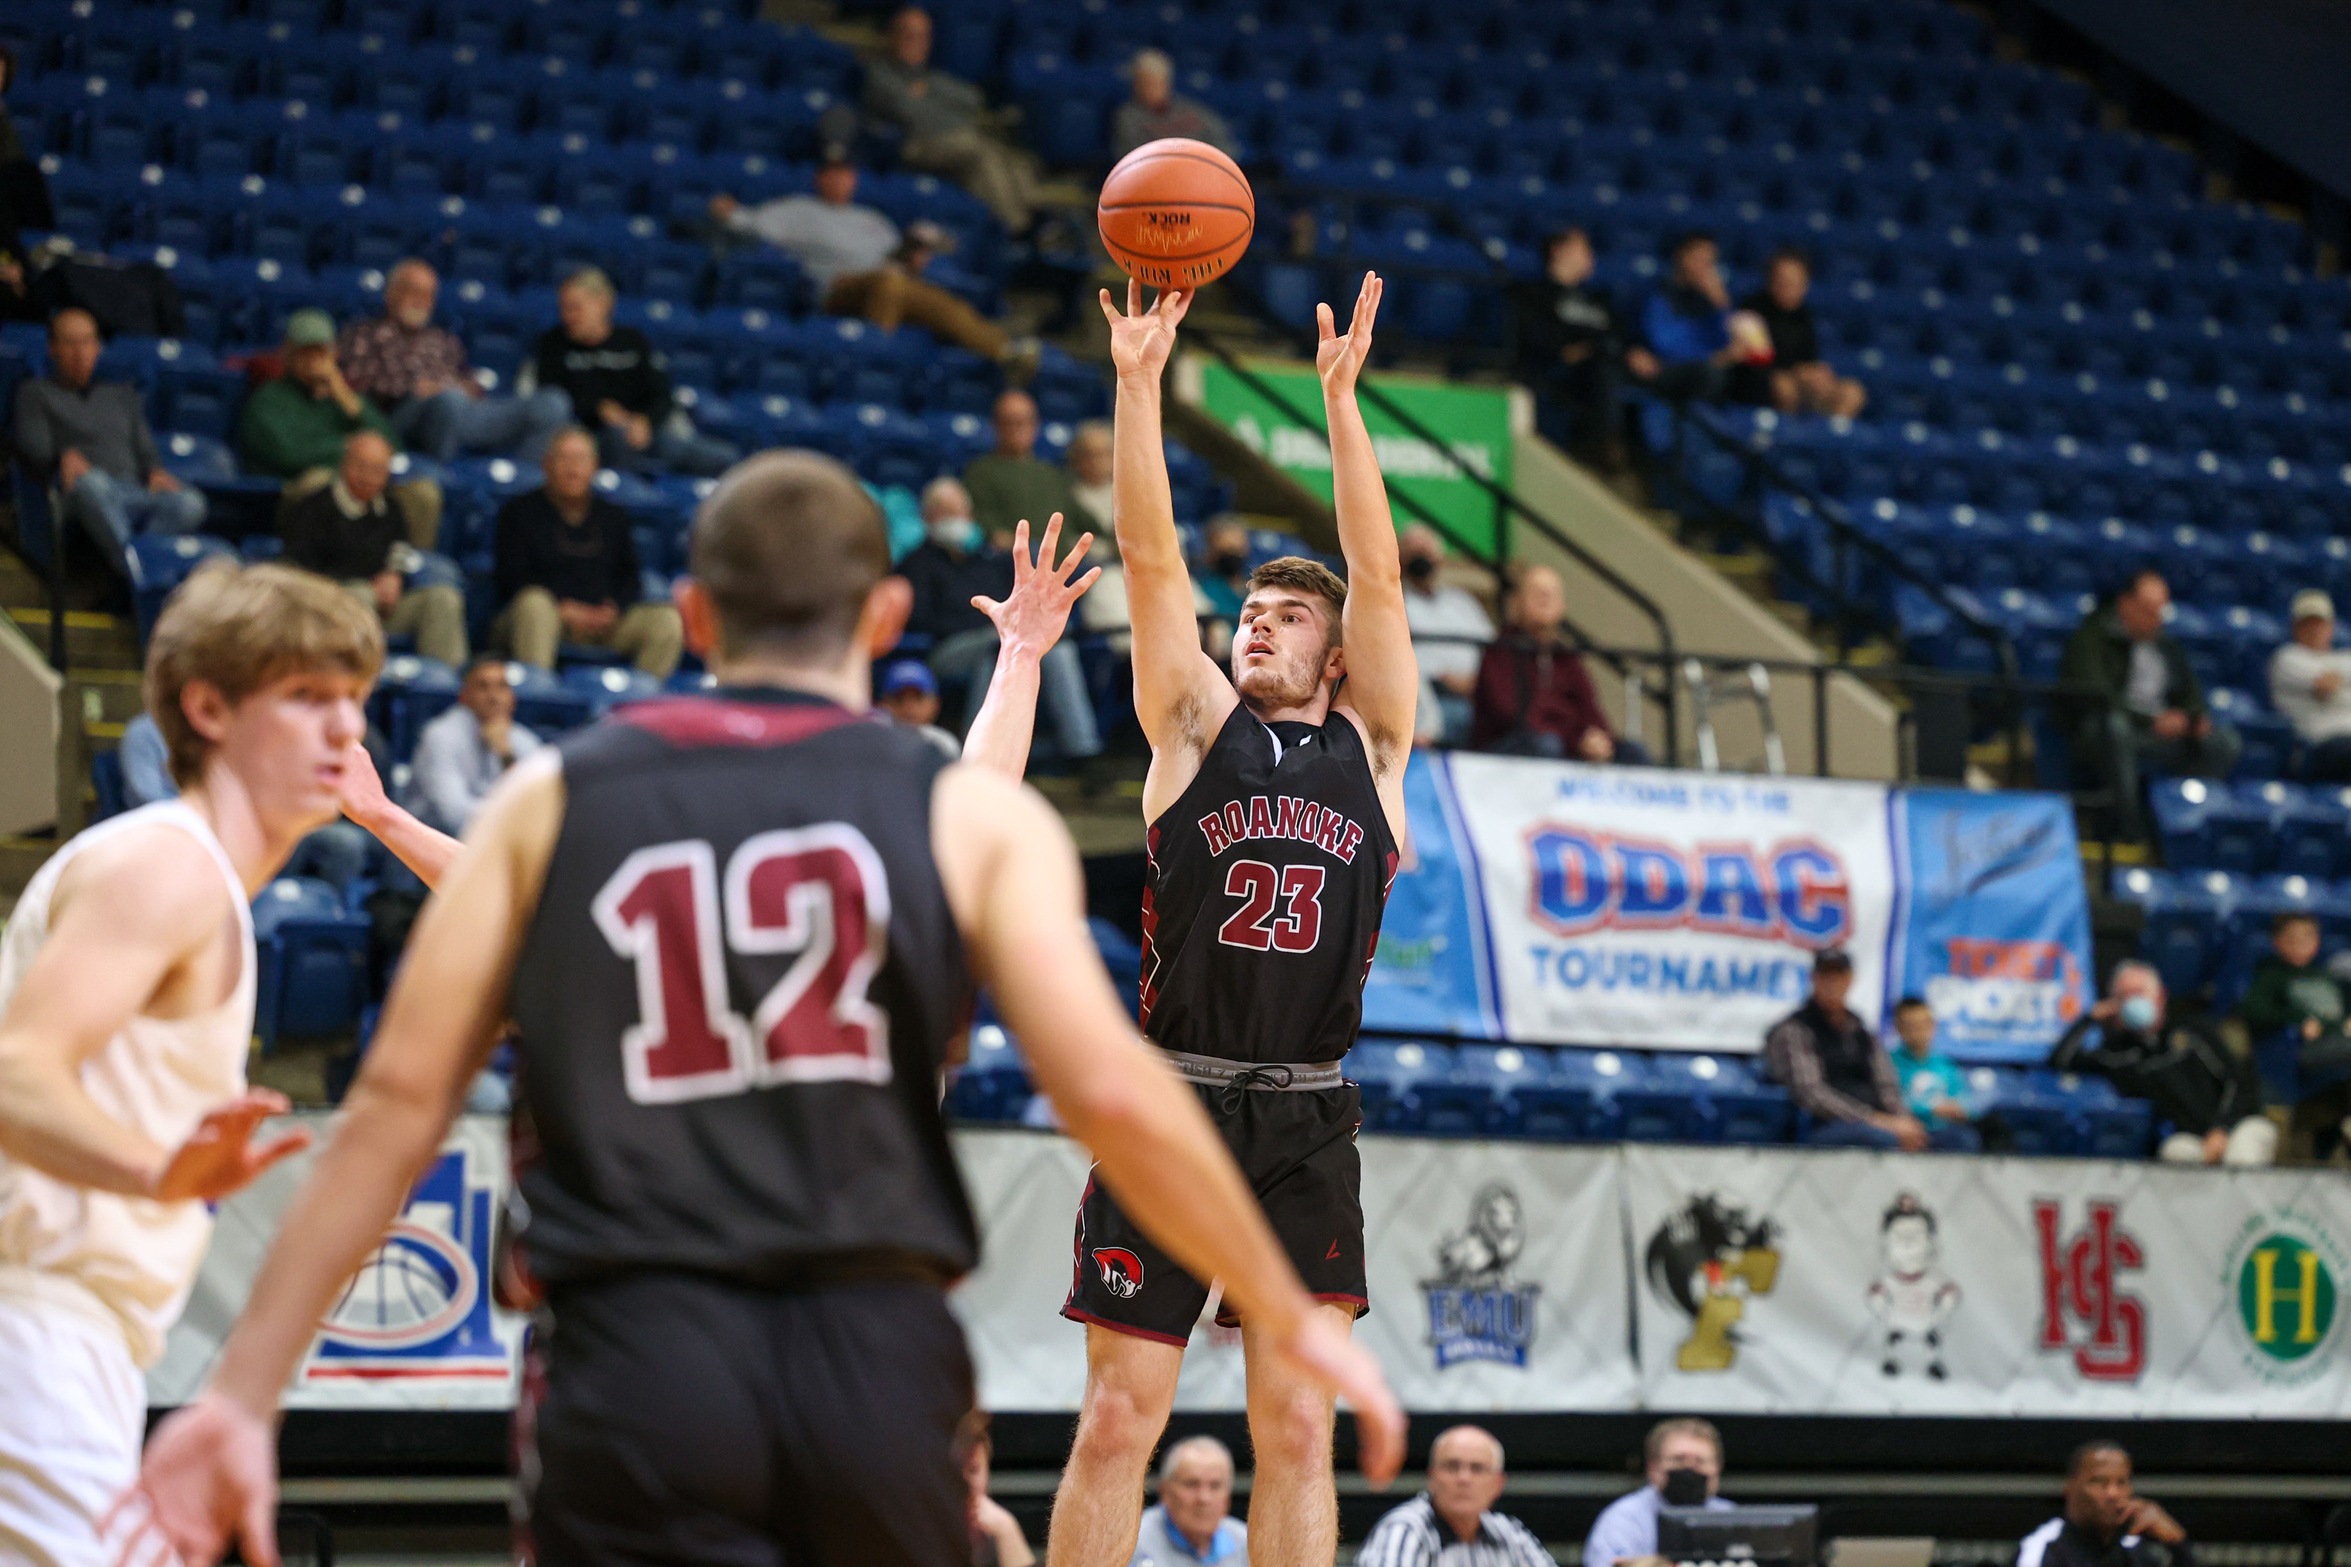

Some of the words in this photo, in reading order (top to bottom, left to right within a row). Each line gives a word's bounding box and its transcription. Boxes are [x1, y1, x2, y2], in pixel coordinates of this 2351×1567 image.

[1198, 796, 1364, 866] ROANOKE
[1218, 859, 1325, 953] 23
[1523, 818, 1853, 950] ODAC
[590, 820, 893, 1105] 12
[1427, 1286, 1534, 1340] EMU
[2252, 1248, 2319, 1343] H
